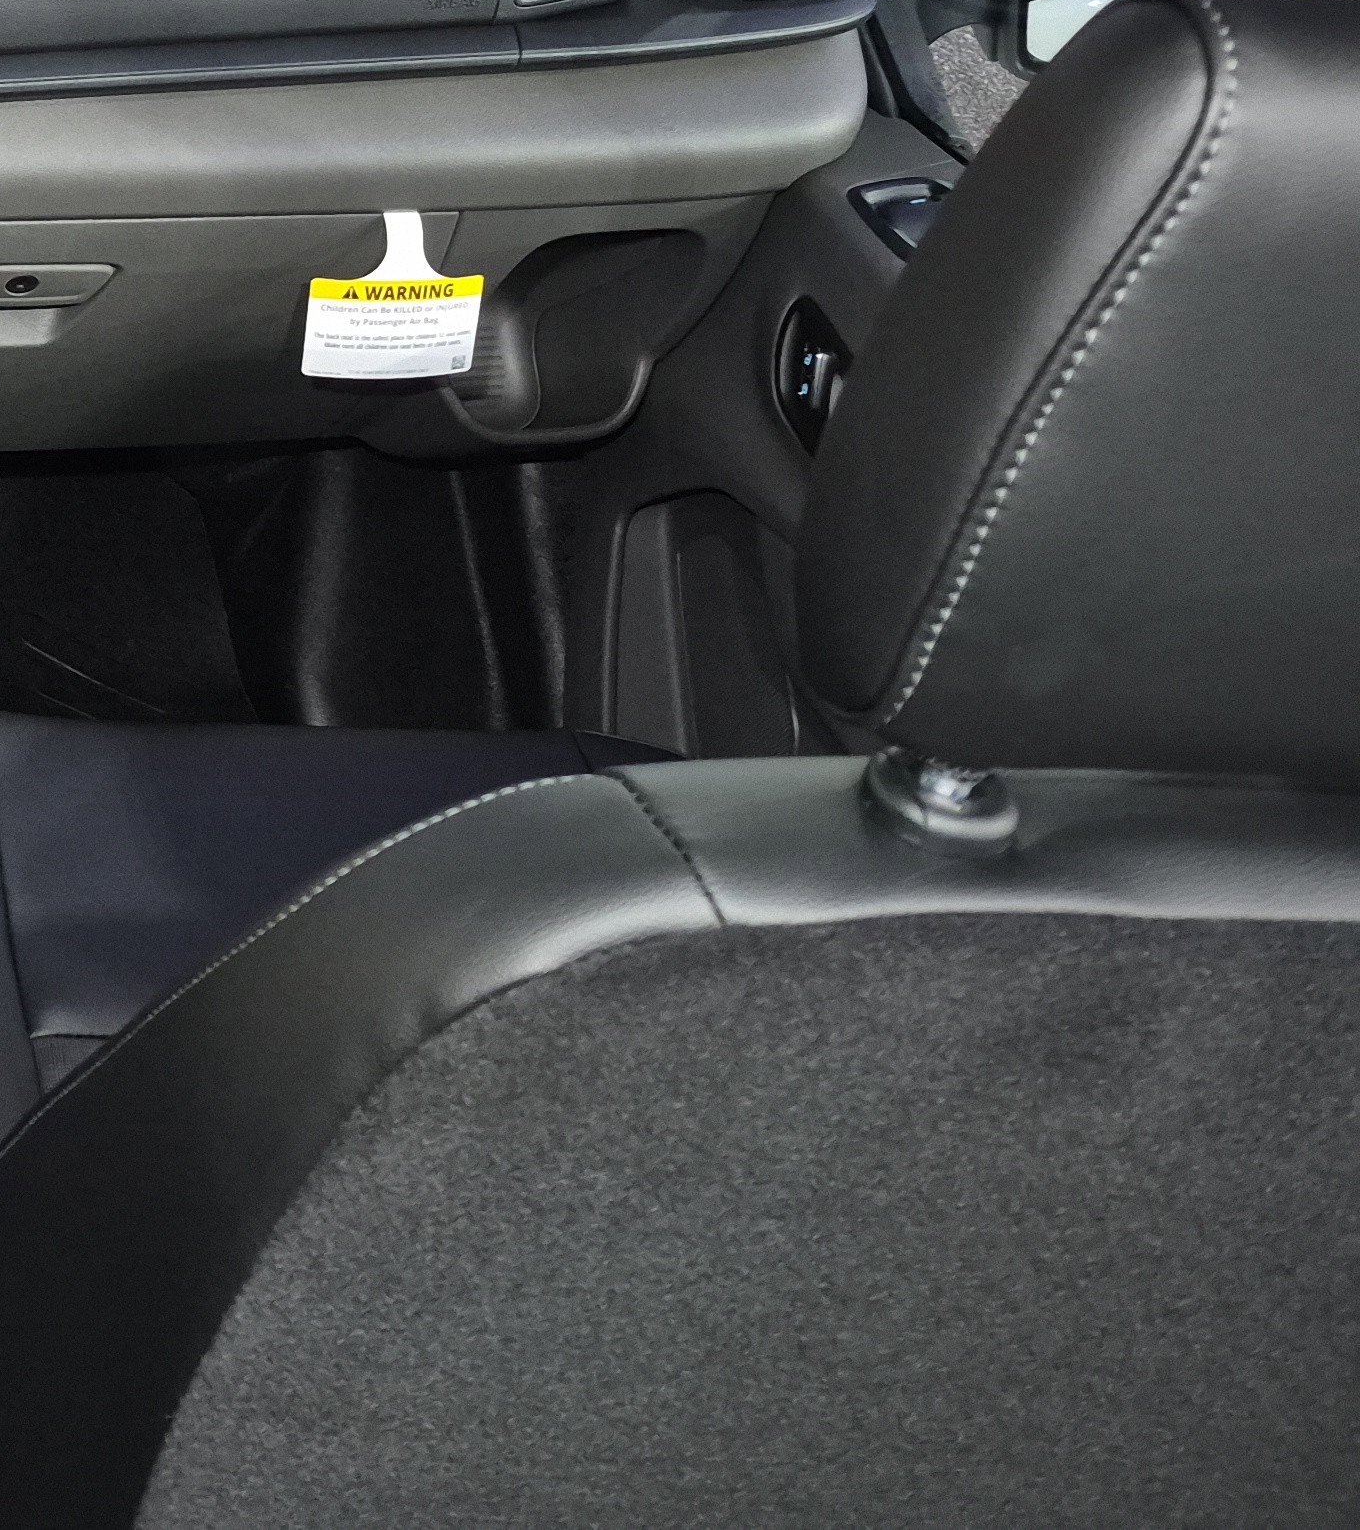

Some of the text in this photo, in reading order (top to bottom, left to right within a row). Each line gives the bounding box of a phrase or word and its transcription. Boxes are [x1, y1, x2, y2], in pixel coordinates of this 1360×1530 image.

[365, 283, 454, 301] WARNING
[321, 304, 359, 313] Children
[361, 306, 378, 314] Can
[394, 306, 422, 314] KILLED
[436, 302, 468, 312] INJURED
[350, 318, 360, 327] by
[363, 318, 406, 327] Passenger
[424, 317, 439, 325] Bag
